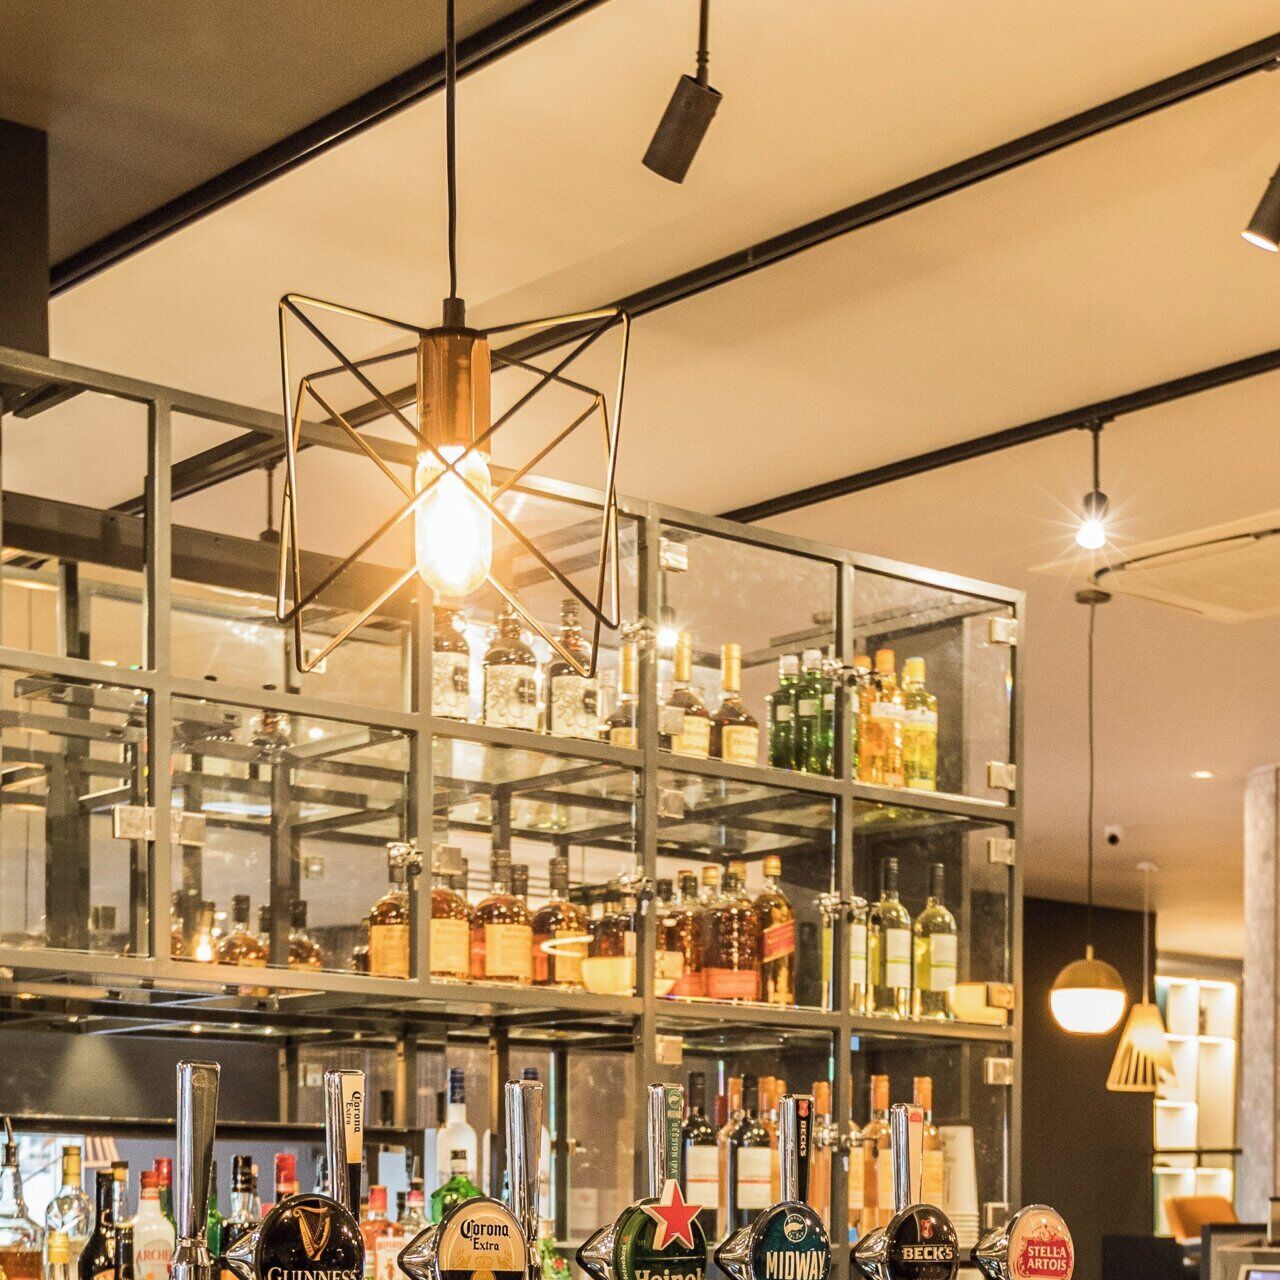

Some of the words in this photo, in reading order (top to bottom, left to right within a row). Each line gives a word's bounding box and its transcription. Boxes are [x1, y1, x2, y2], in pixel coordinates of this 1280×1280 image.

[351, 1090, 362, 1135] Corona
[671, 1122, 679, 1157] SESSION
[671, 1160, 679, 1174] IPA
[460, 1219, 511, 1241] Corona
[472, 1237, 500, 1251] Extra
[136, 1250, 172, 1262] ARCHE
[1027, 1246, 1067, 1258] STELLA
[766, 1250, 826, 1280] MIDWAY
[1027, 1258, 1067, 1271] ARTOIS
